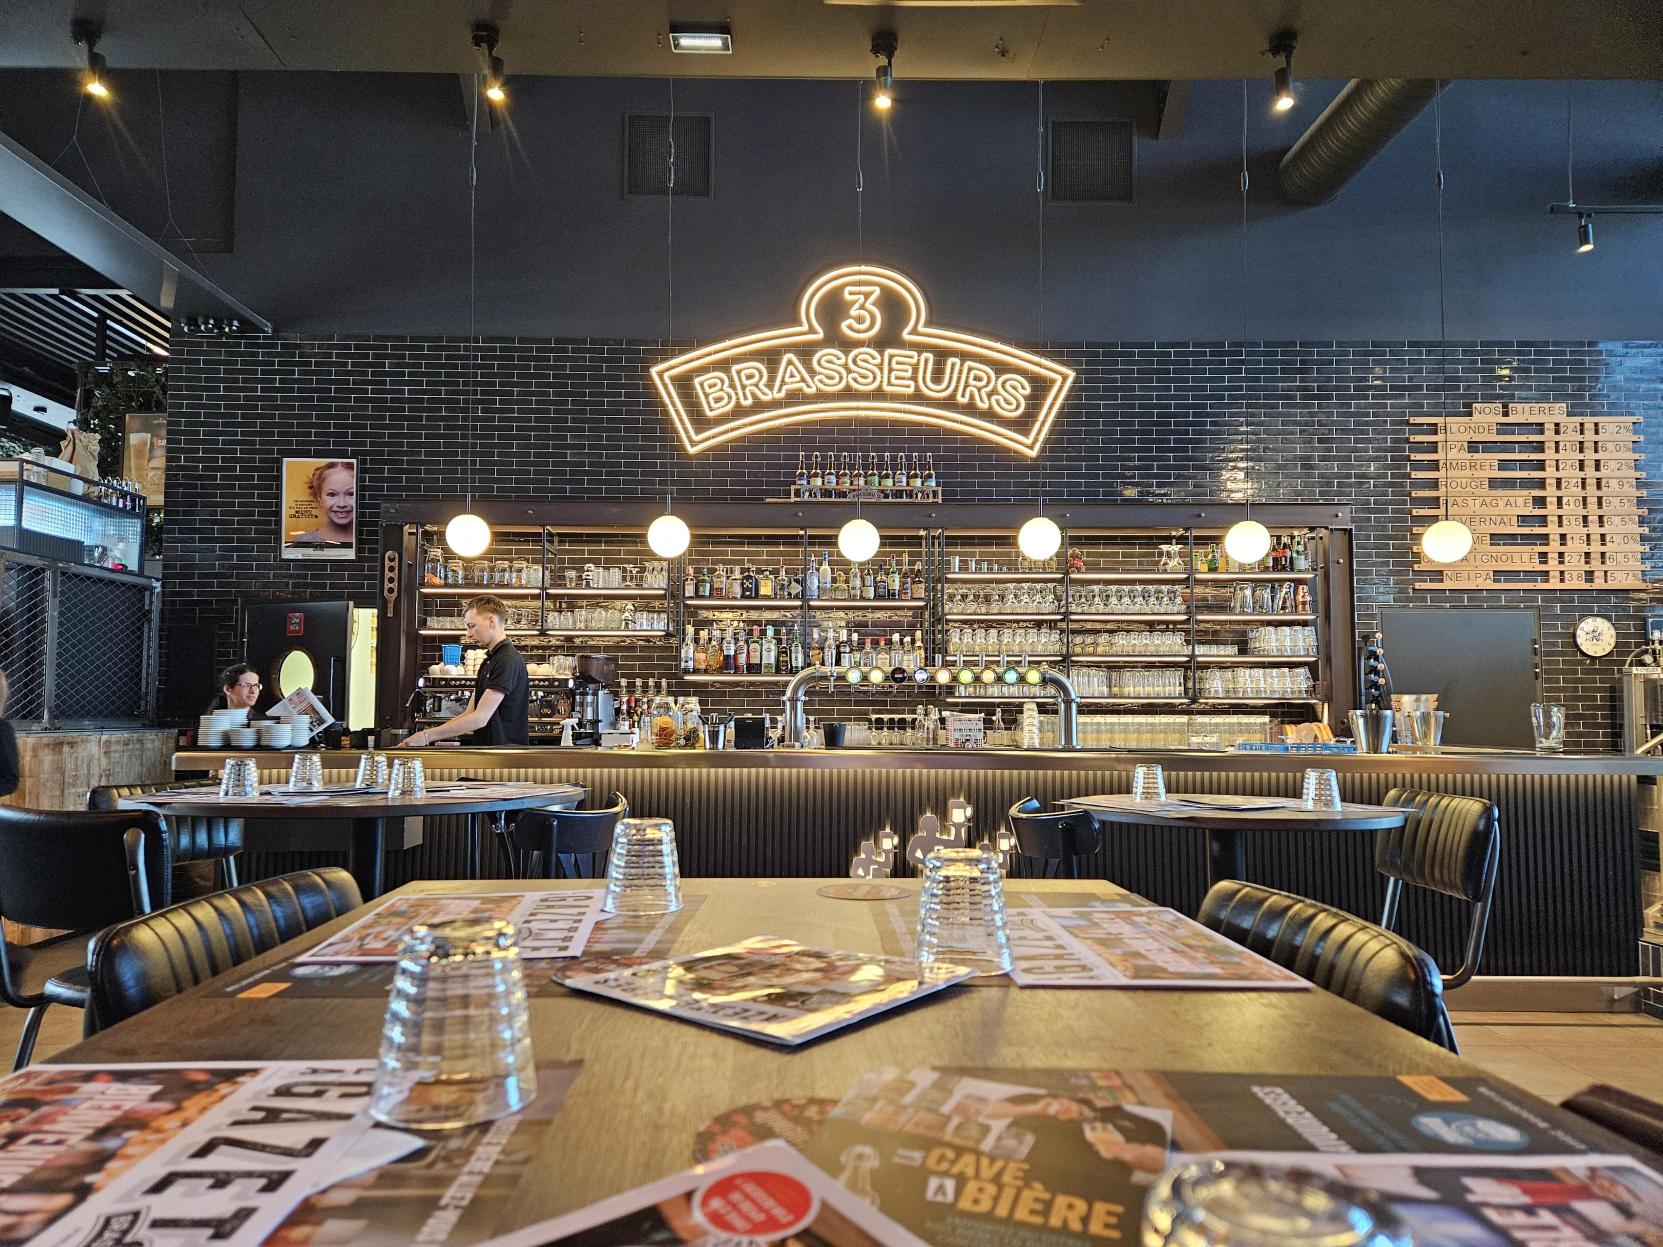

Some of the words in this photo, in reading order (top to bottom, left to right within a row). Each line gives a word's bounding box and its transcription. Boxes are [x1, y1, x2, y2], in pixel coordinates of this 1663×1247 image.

[839, 286, 882, 338] 3
[693, 347, 1032, 419] BRASSEURS
[1474, 406, 1501, 416] NOS
[1510, 406, 1566, 416] BIERES
[1439, 425, 1495, 435] BLONDE
[1562, 425, 1578, 435] 24
[1441, 443, 1467, 453] IPA
[1561, 443, 1577, 453] 40
[1440, 461, 1497, 471] AMBREE
[1561, 461, 1578, 471] 26
[1440, 480, 1488, 490] ROUGE
[1563, 480, 1579, 490] 24
[1564, 499, 1581, 508] 40
[1565, 517, 1581, 527] 35
[1569, 535, 1585, 545] 15
[1422, 553, 1537, 564] CAIGNOLLE
[1567, 554, 1583, 564] 27
[1445, 572, 1494, 582] NEIPA
[1566, 572, 1583, 582] 38
[520, 895, 594, 952] GAZETTE
[925, 1146, 1031, 1188] CAVE
[956, 1178, 1126, 1240] BIÈRE
